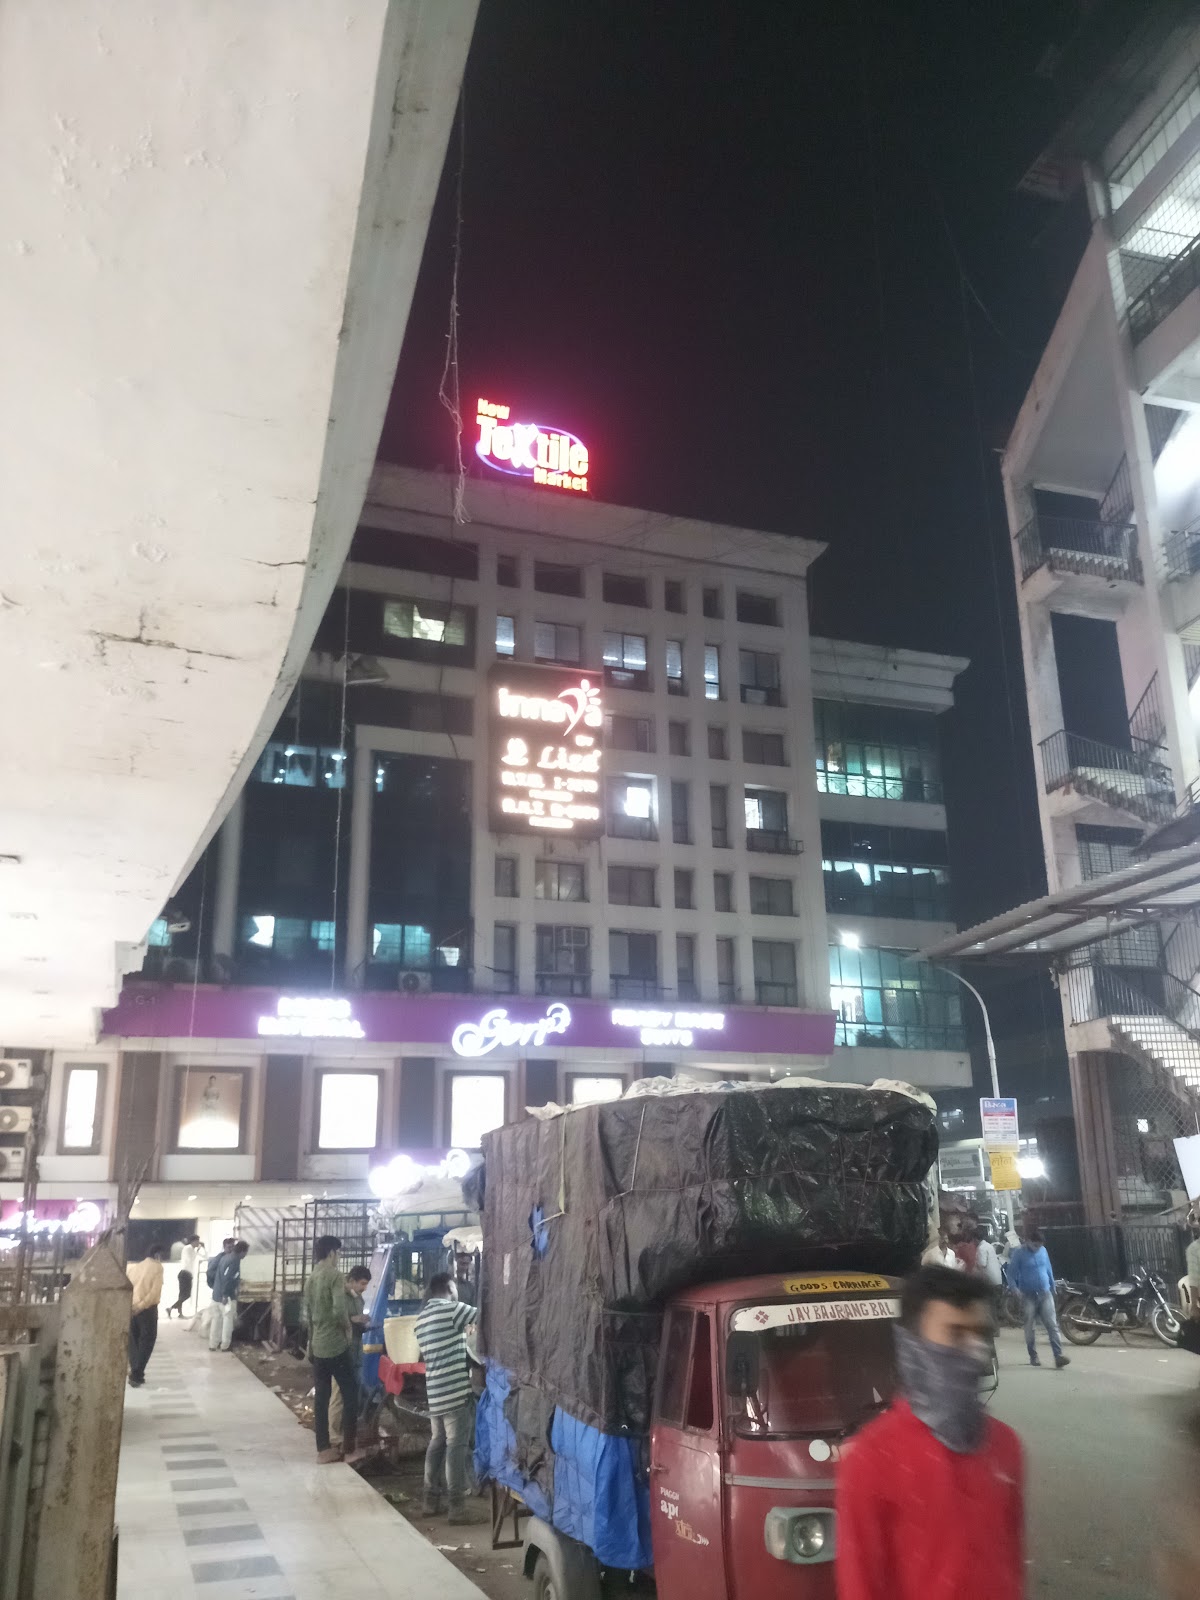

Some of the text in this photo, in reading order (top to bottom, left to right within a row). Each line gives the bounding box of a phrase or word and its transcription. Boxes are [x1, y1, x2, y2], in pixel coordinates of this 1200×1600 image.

[534, 467, 588, 491] Market
[790, 1280, 882, 1292] GOODS CARRIAGE
[788, 1302, 895, 1322] JAY BAJRANG BAL
